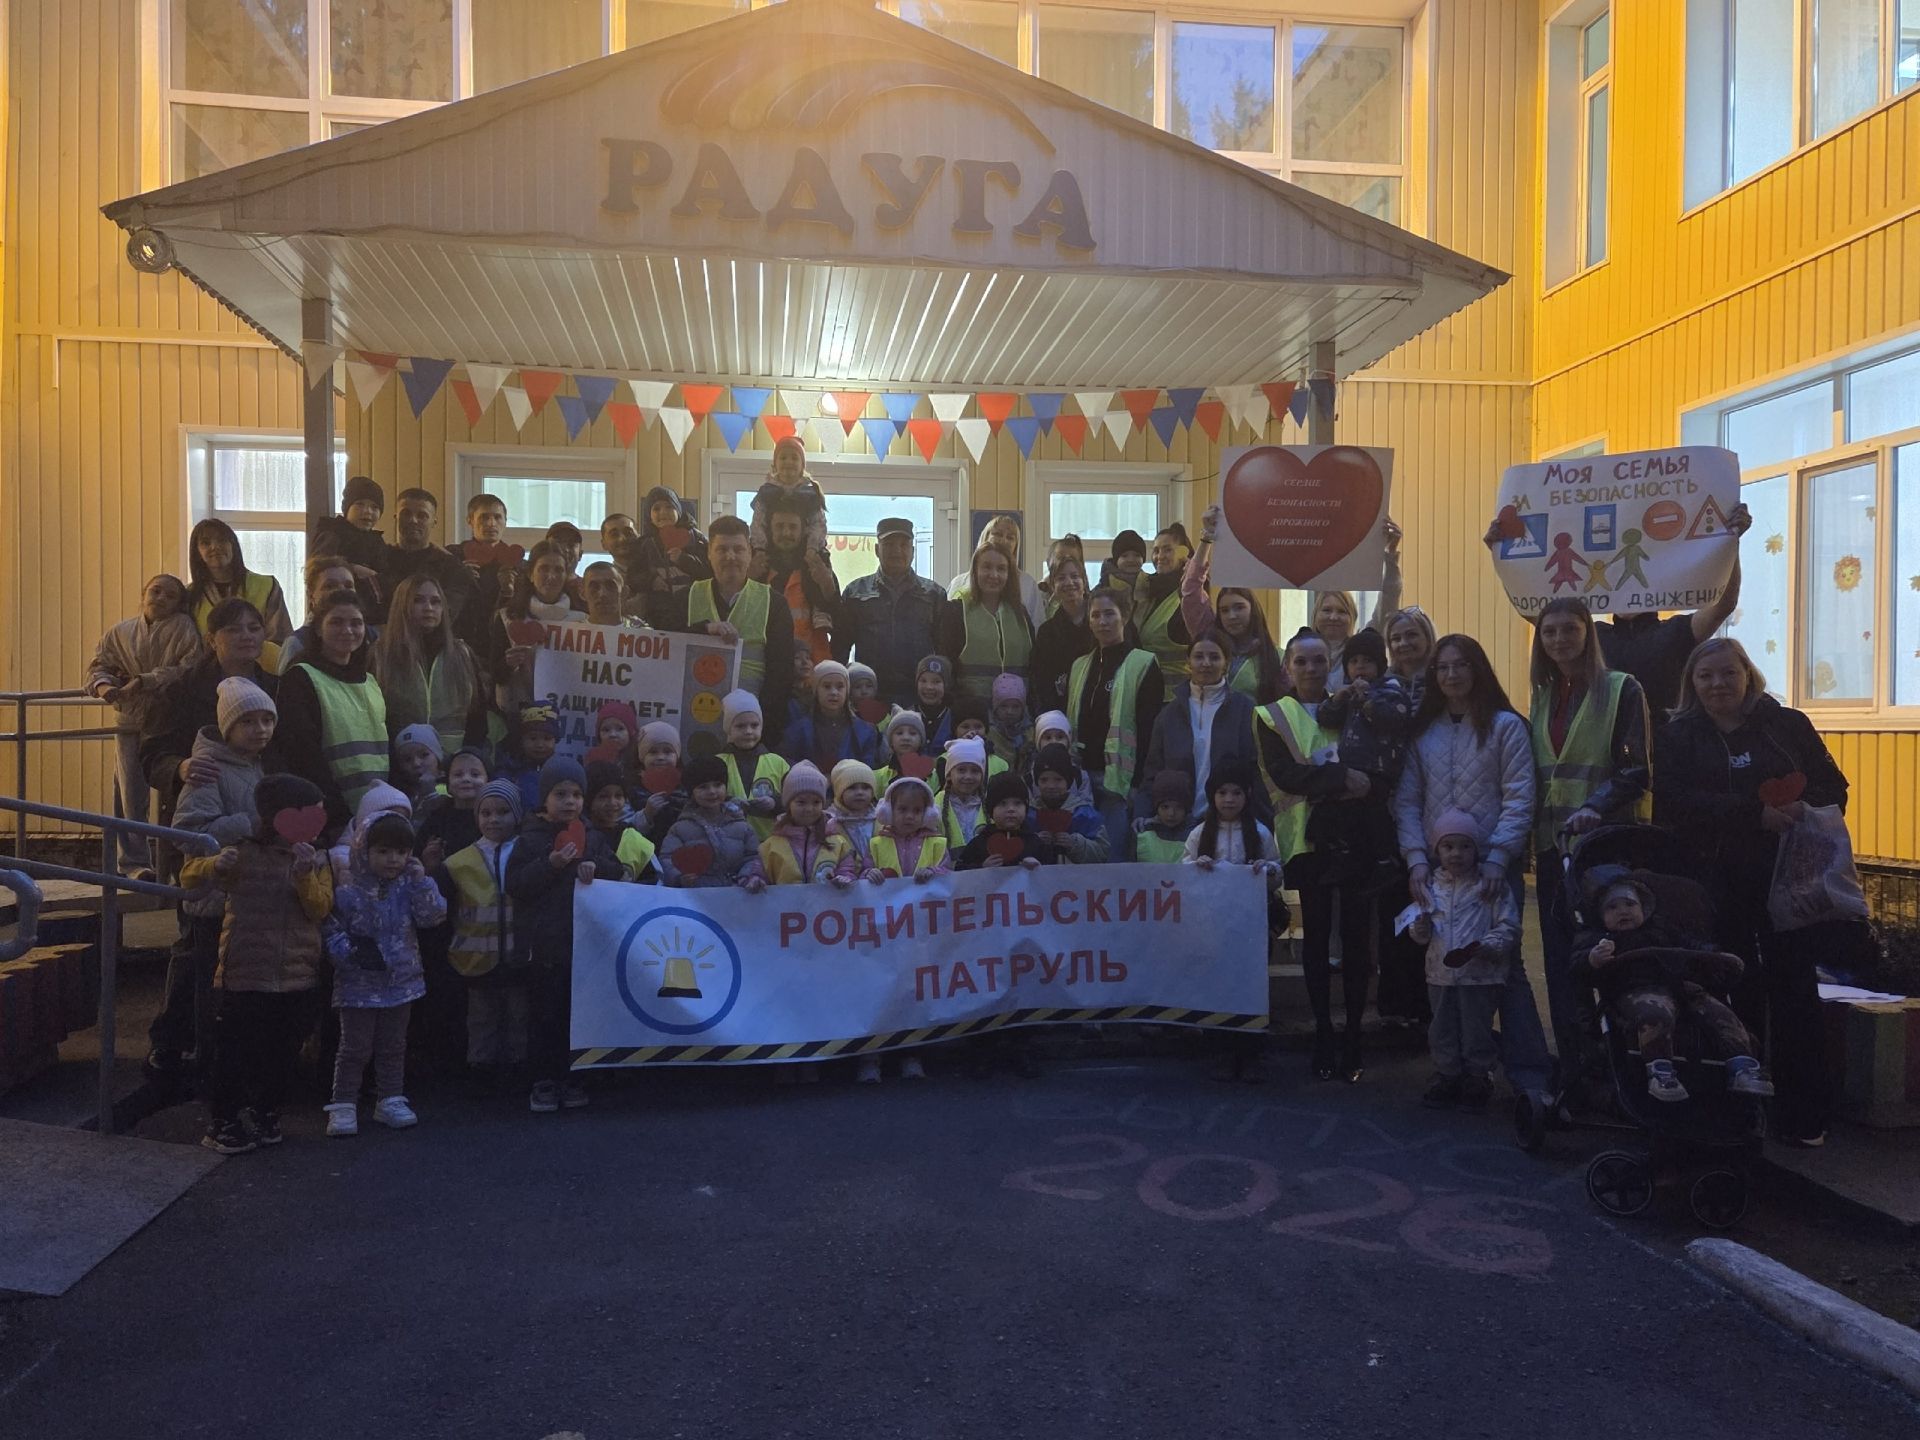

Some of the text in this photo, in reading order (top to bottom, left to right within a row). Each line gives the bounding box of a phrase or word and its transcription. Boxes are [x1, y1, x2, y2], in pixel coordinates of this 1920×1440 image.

[600, 138, 1097, 251] РАДУГА
[1613, 455, 1690, 480] СЕМЬЯ
[1512, 478, 1698, 512] ЗА БЕЗОПАСНОСТЬ
[544, 625, 670, 660] ПАПА МОЙ
[581, 660, 633, 686] НАС
[779, 882, 1182, 949] РОДИТЕЛЬСКИЙ
[915, 950, 1129, 1000] ПАТРУЛЬ
[1001, 1132, 1554, 1283] 2026
